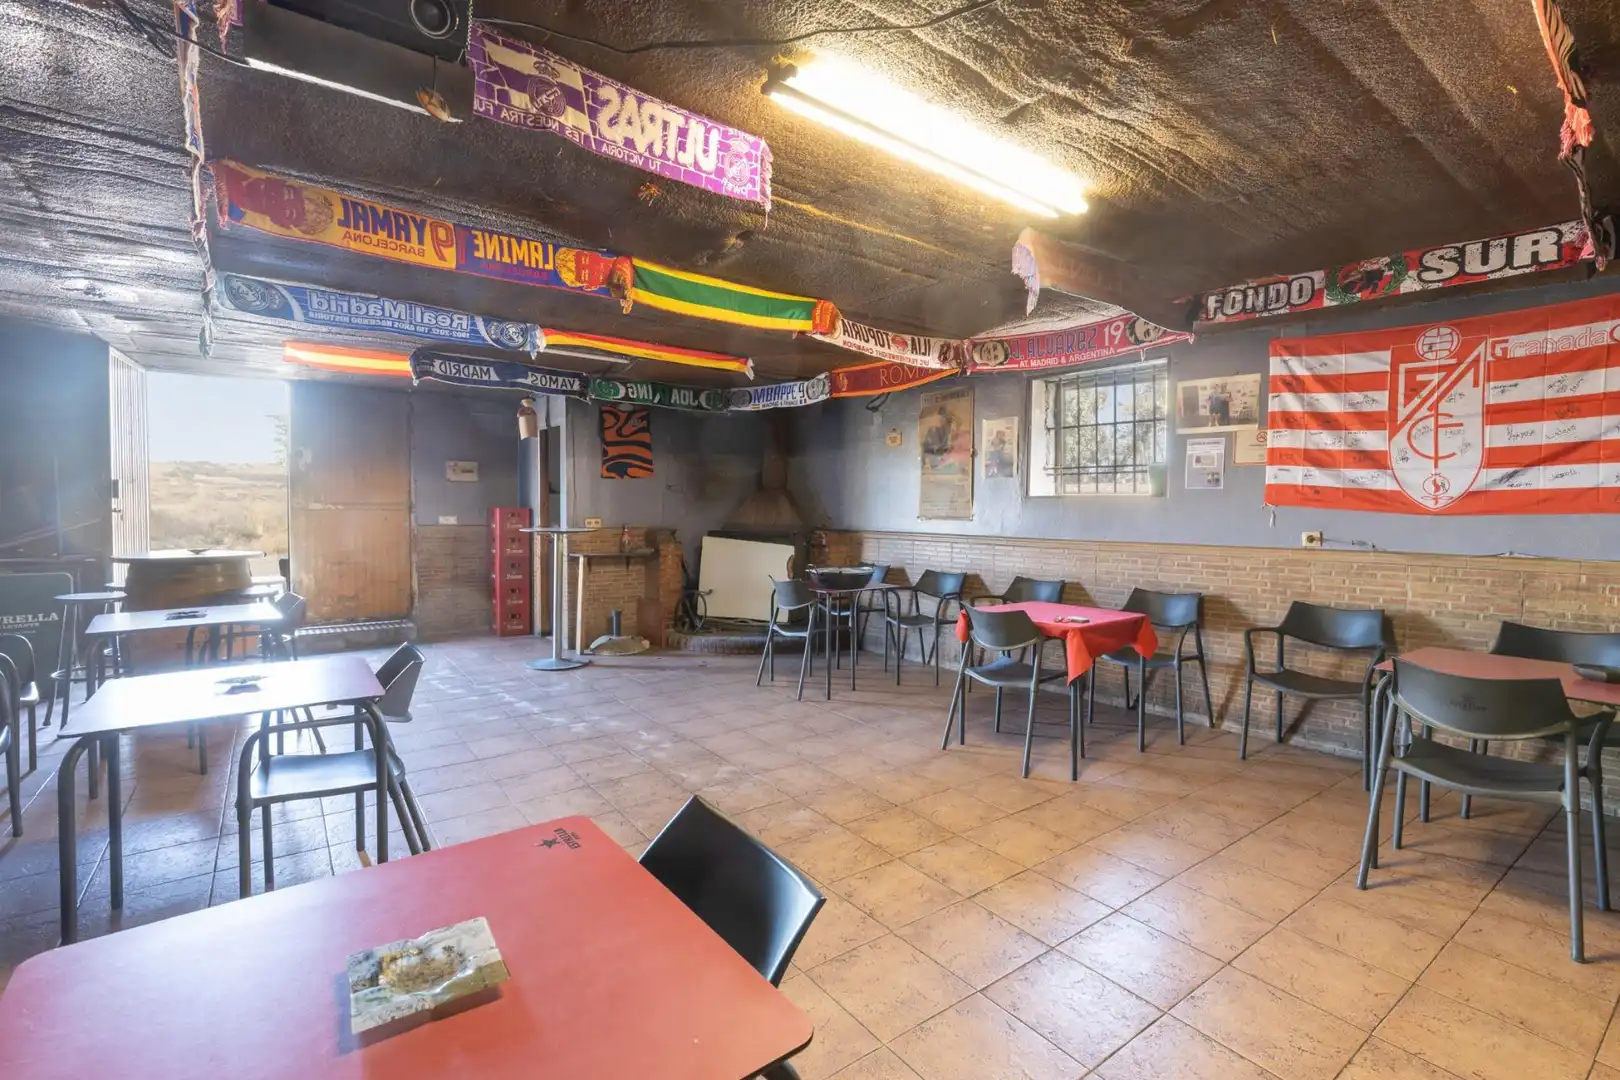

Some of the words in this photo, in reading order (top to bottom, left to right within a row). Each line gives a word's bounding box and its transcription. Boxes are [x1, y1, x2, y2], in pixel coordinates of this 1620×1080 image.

[1206, 276, 1315, 320] FONDO
[1418, 228, 1565, 283] SUR
[1103, 320, 1125, 347] 19
[1488, 325, 1609, 361] Granada
[1031, 357, 1059, 367] MADRID
[1069, 347, 1116, 362] ARGENTINA
[753, 384, 797, 403] MBAPPE
[798, 382, 805, 399] 9
